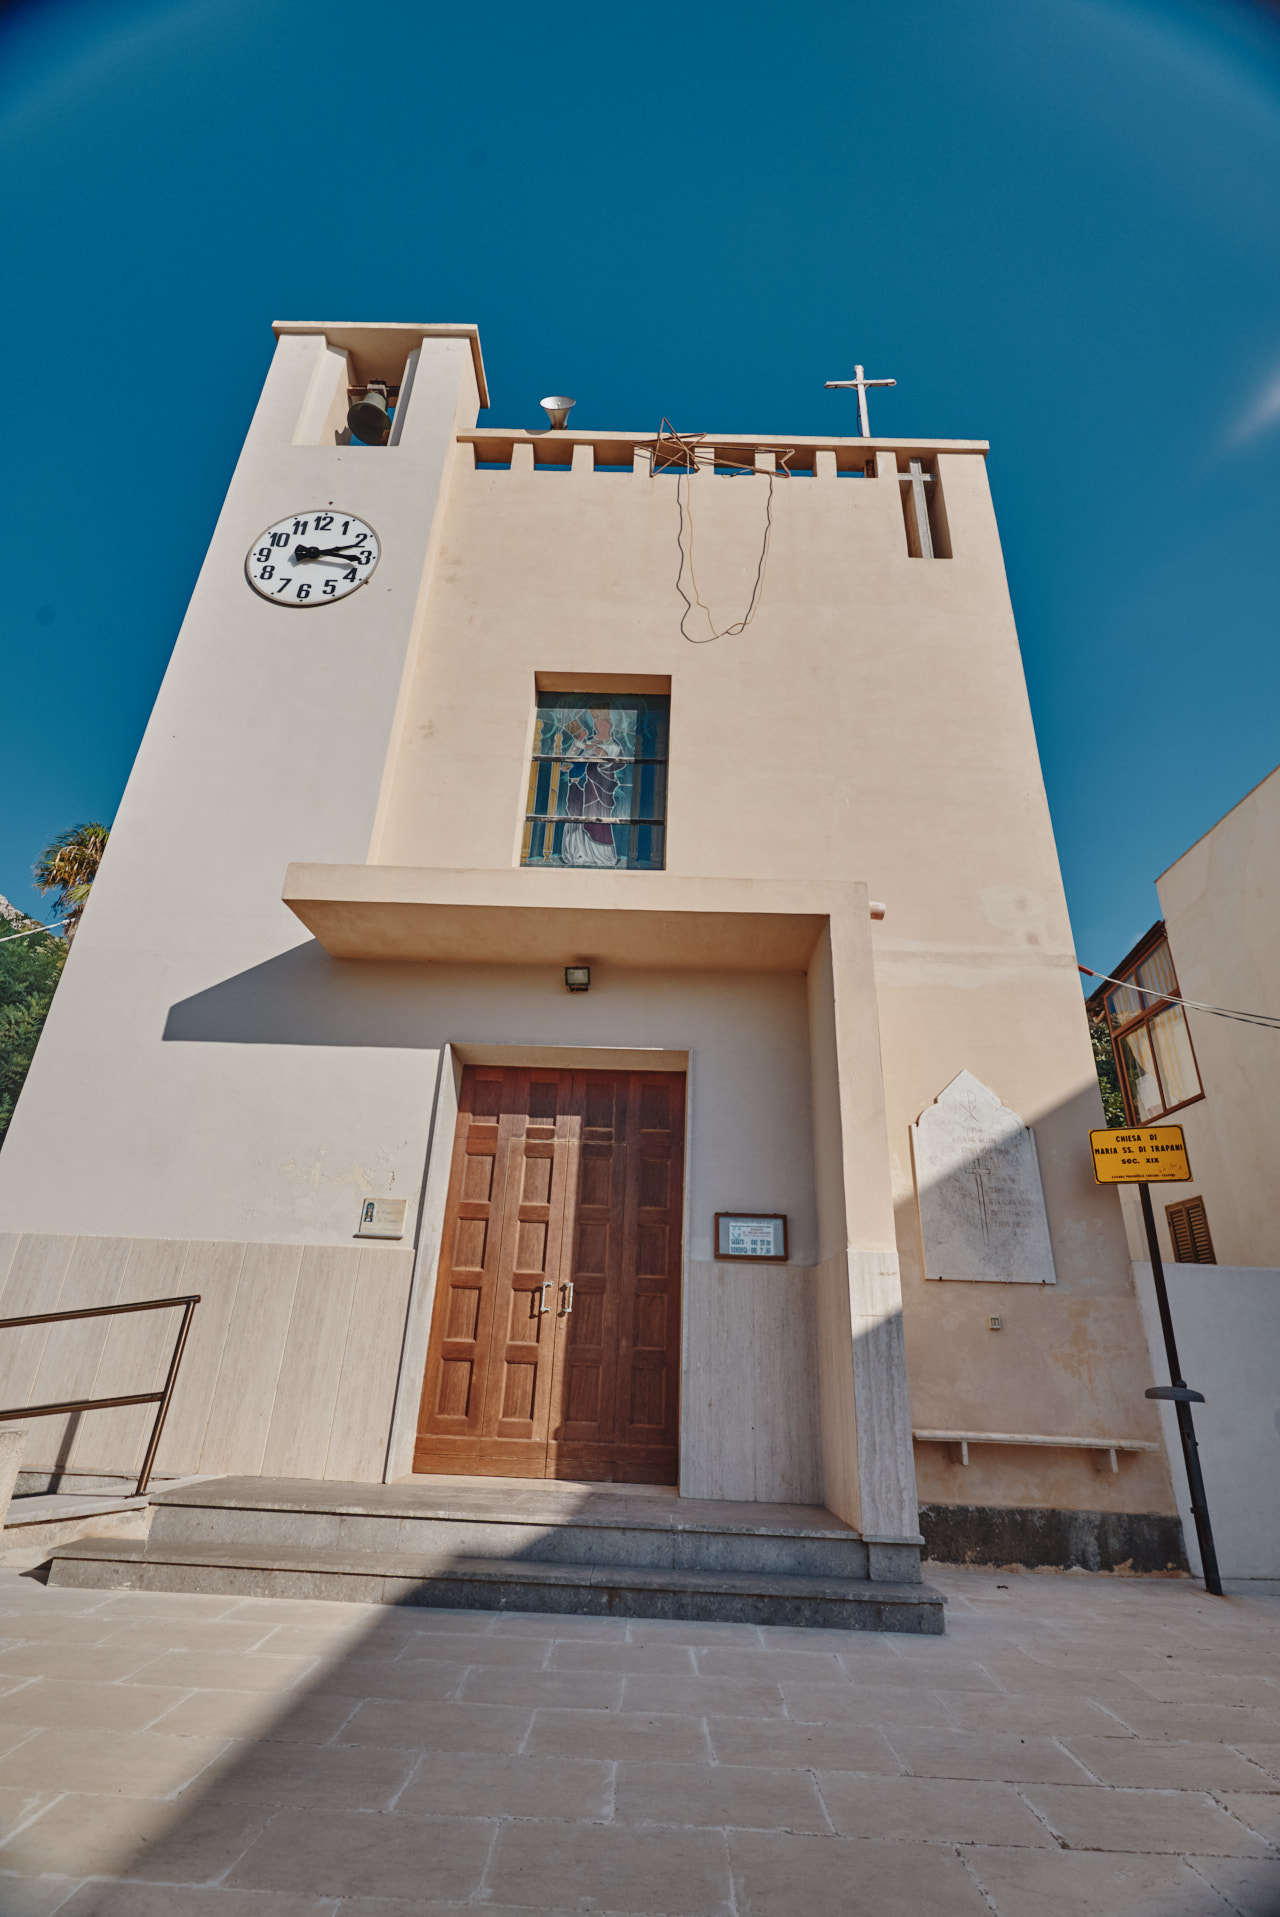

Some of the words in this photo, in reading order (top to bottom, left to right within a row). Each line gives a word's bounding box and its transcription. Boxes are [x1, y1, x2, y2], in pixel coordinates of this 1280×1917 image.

[292, 520, 309, 536] 11
[314, 516, 335, 531] 12
[341, 520, 350, 536] 1
[269, 532, 291, 548] 10
[353, 533, 368, 548] 2
[256, 547, 272, 563] 9
[357, 550, 373, 566] 3
[259, 565, 276, 580] 8
[342, 567, 358, 583] 4
[276, 578, 293, 594] 7
[296, 583, 312, 599] 6
[322, 579, 339, 595] 5
[1115, 1134, 1142, 1142] CHIESA
[1094, 1147, 1118, 1155] MARIA
[1150, 1144, 1183, 1152] TRAPANI
